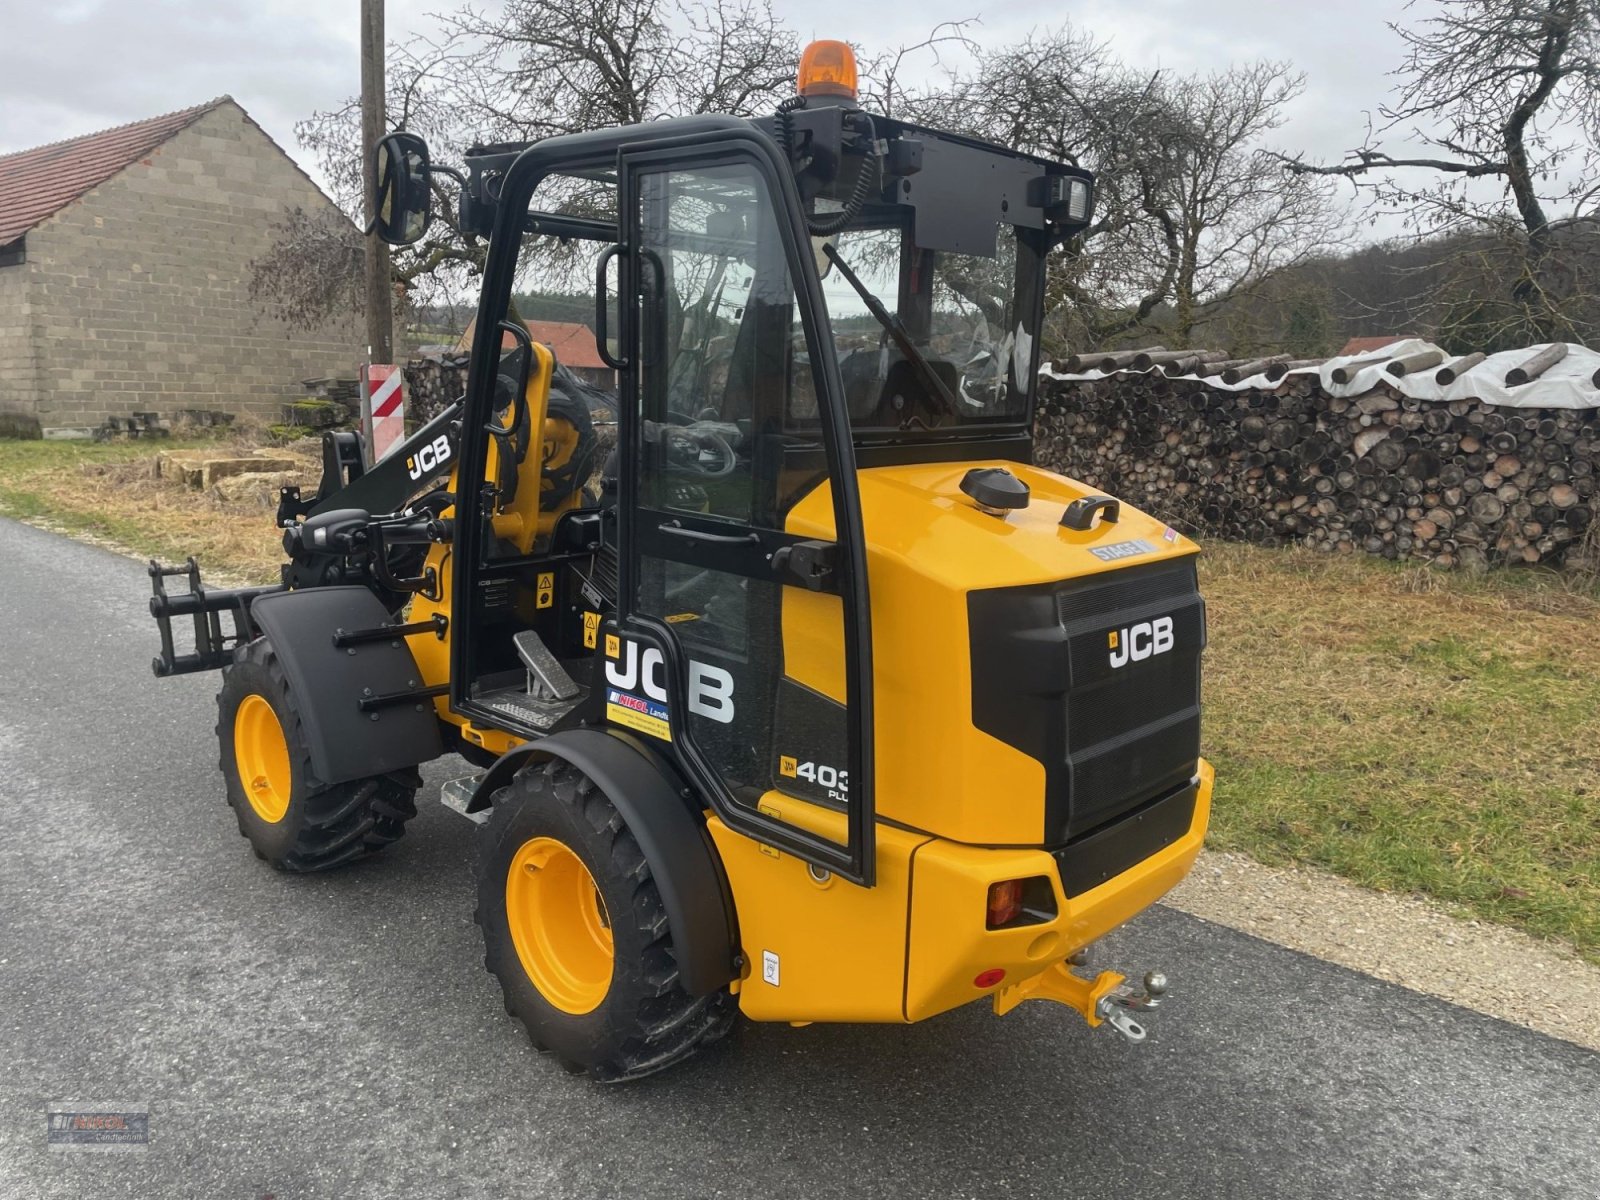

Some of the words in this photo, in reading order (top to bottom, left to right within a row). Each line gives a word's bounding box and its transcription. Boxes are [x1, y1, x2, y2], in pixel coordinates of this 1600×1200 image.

[410, 434, 451, 480] JCB
[1091, 542, 1142, 560] STAGE
[1109, 616, 1174, 668] JCB
[605, 640, 735, 723] JCB
[619, 694, 649, 714] NIKOL
